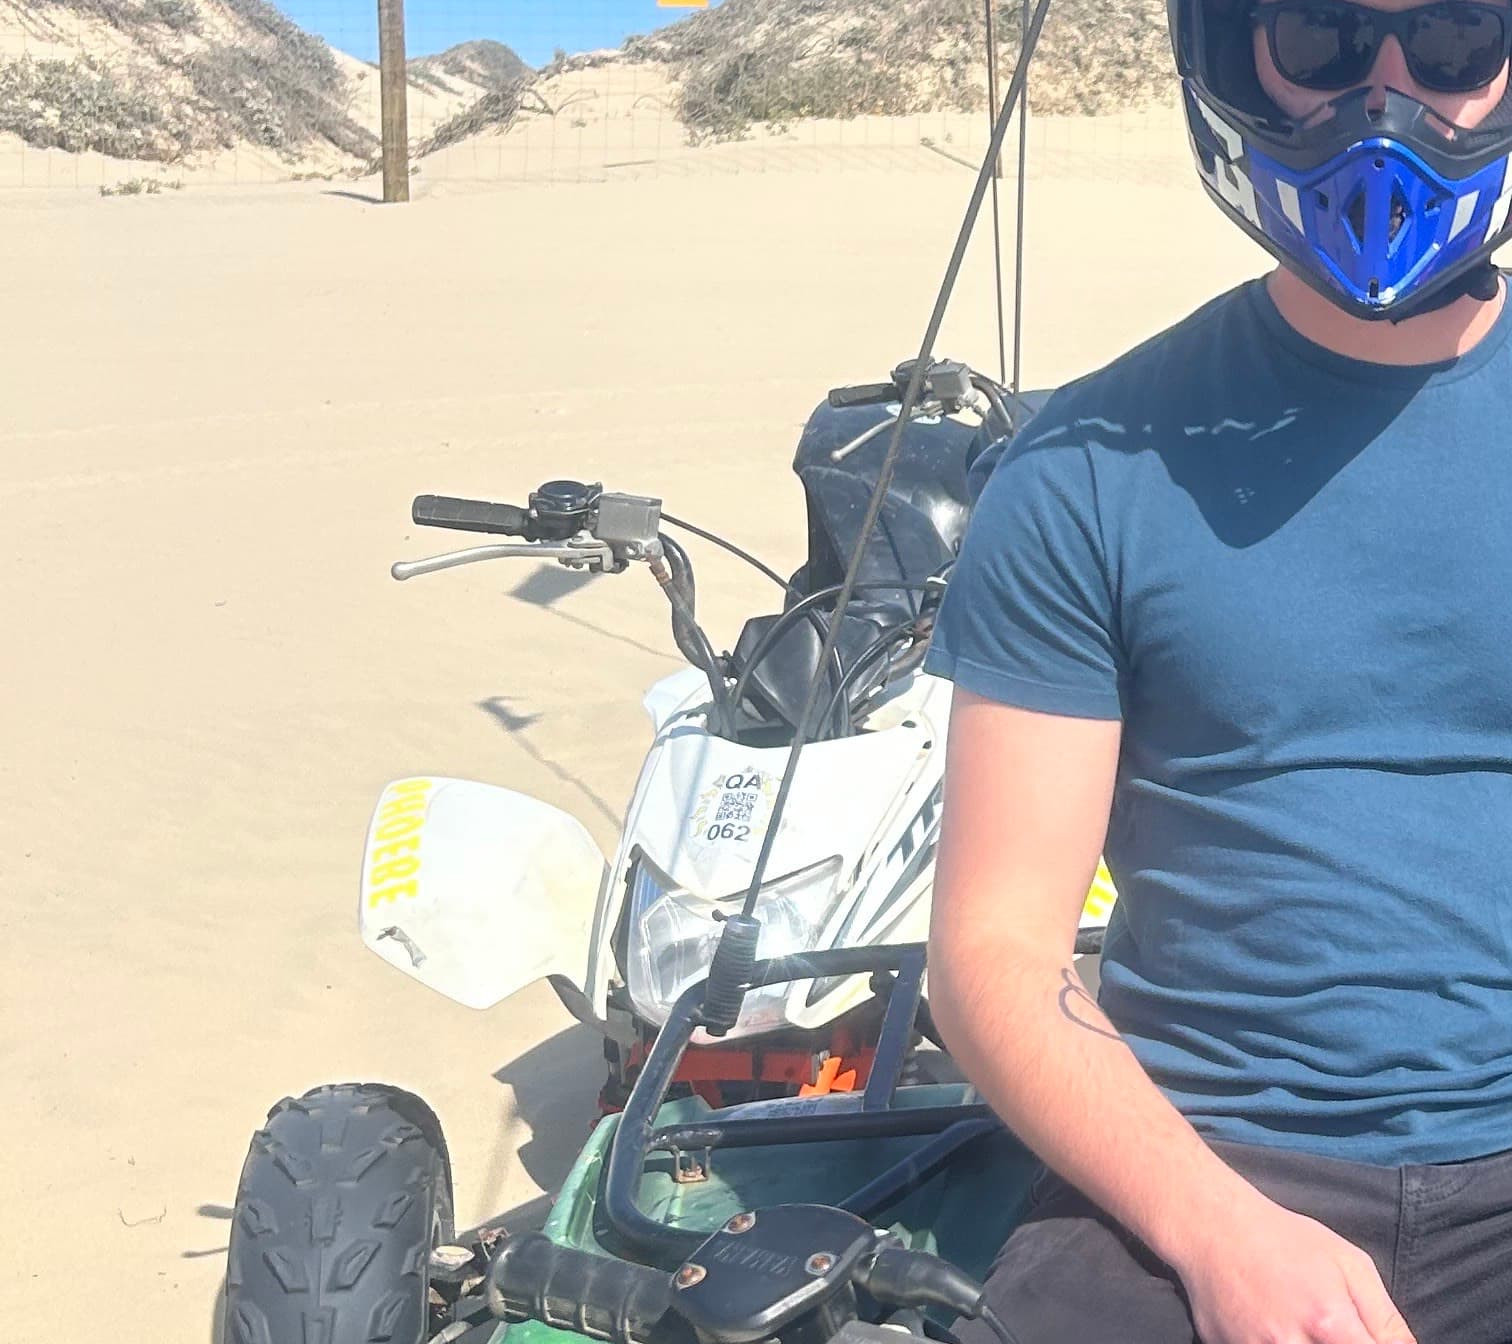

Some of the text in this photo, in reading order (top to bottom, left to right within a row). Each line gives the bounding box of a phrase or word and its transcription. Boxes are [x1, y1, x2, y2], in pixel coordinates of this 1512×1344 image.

[725, 773, 762, 790] QA
[706, 822, 752, 842] 062
[369, 779, 434, 908] PHOEBE
